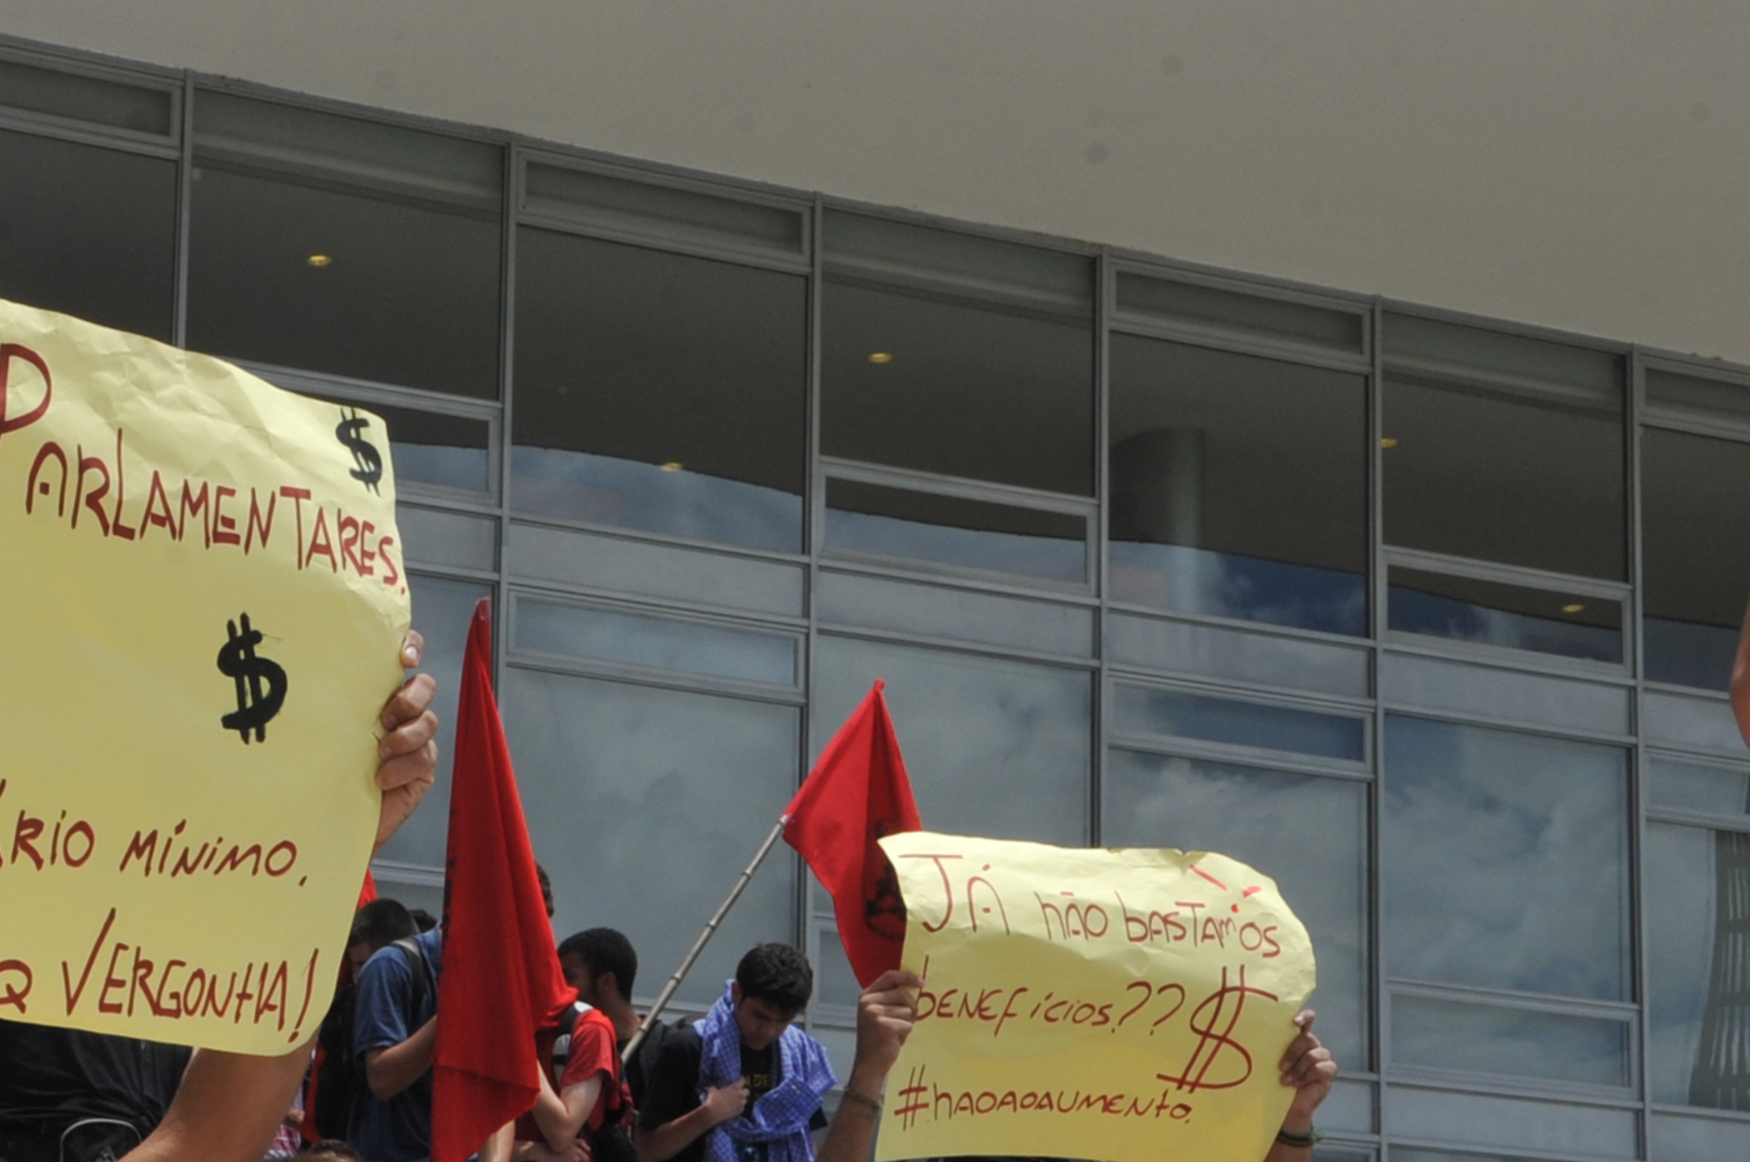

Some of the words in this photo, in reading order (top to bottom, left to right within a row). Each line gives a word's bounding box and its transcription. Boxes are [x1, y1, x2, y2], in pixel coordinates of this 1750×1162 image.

[216, 612, 288, 745] $
[898, 853, 1011, 936] JÁ
[61, 907, 320, 1043] VERGONHA!
[1156, 965, 1279, 1094] $
